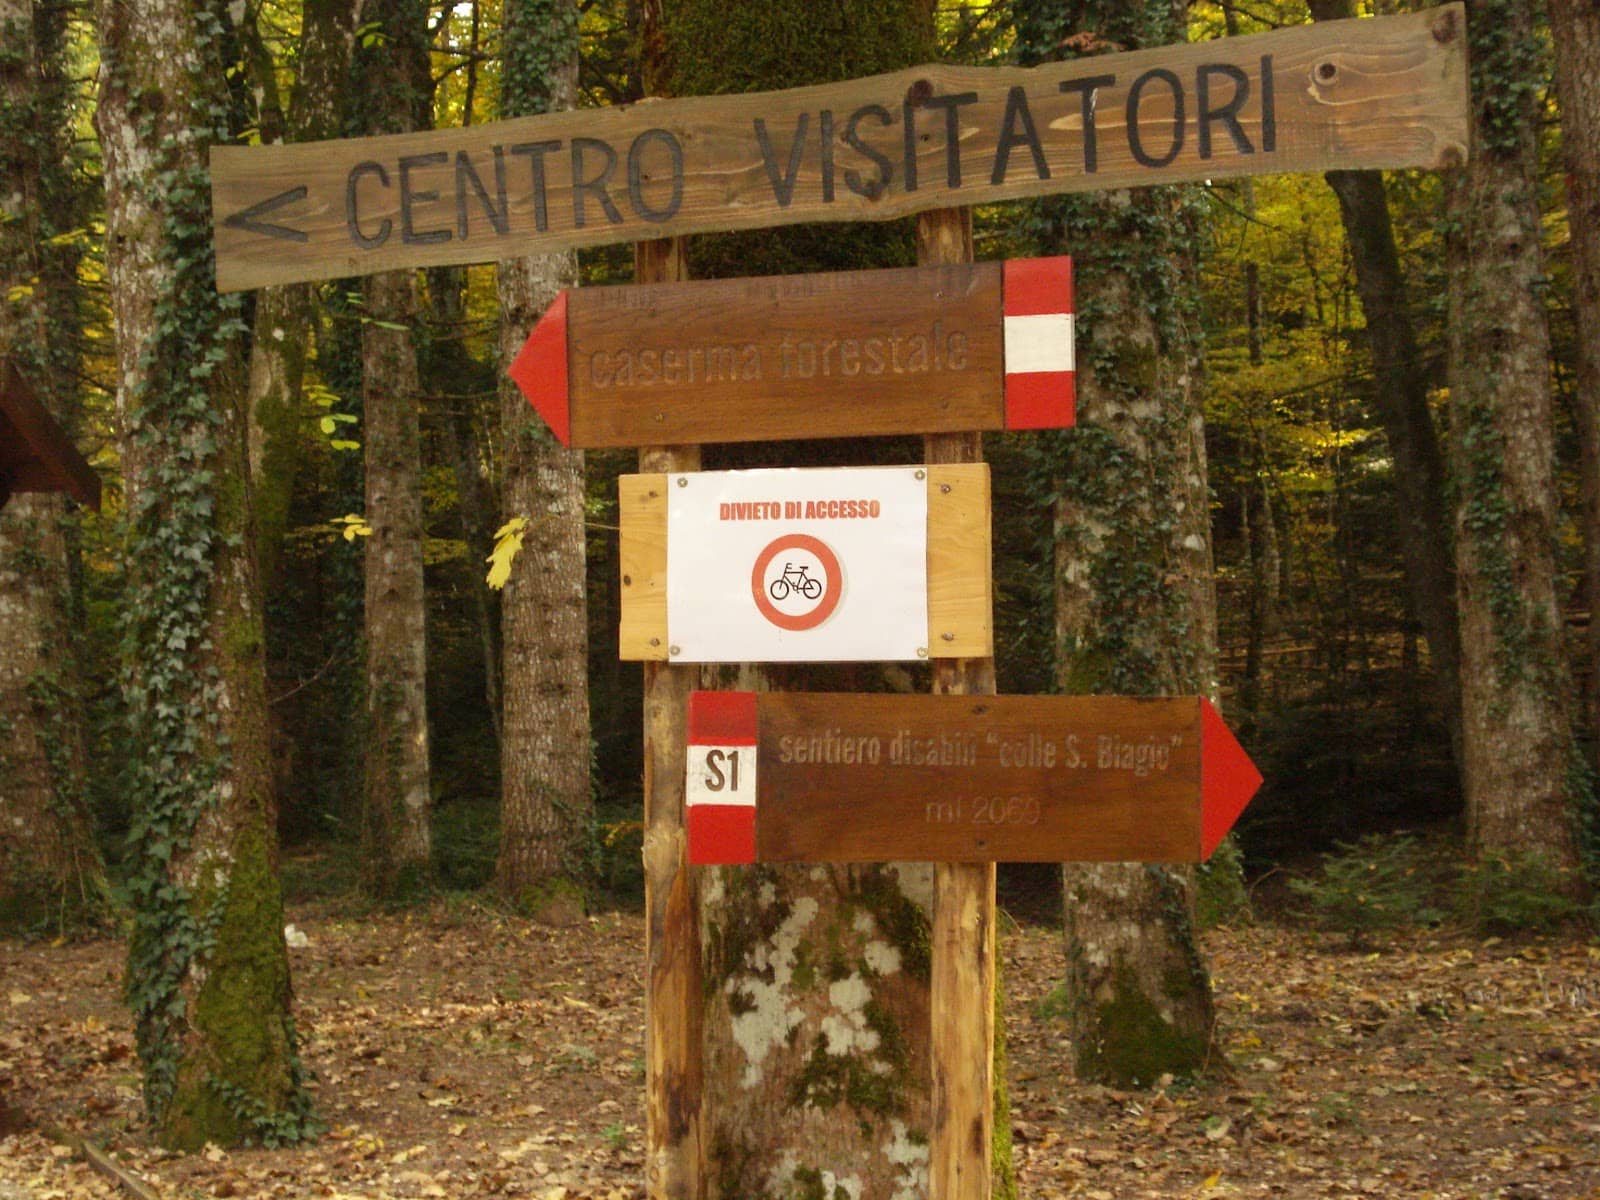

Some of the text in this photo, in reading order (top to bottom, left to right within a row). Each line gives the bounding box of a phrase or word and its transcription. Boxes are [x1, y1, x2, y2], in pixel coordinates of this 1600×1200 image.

[346, 53, 1277, 250] CENTRO VISITATORI
[590, 320, 969, 389] caserma forestale
[719, 499, 881, 521] DIVIETO DI ACCESSO
[779, 728, 881, 765] sentiero
[889, 729, 977, 767] disabili
[1064, 734, 1088, 769] S.
[704, 749, 740, 792] S1
